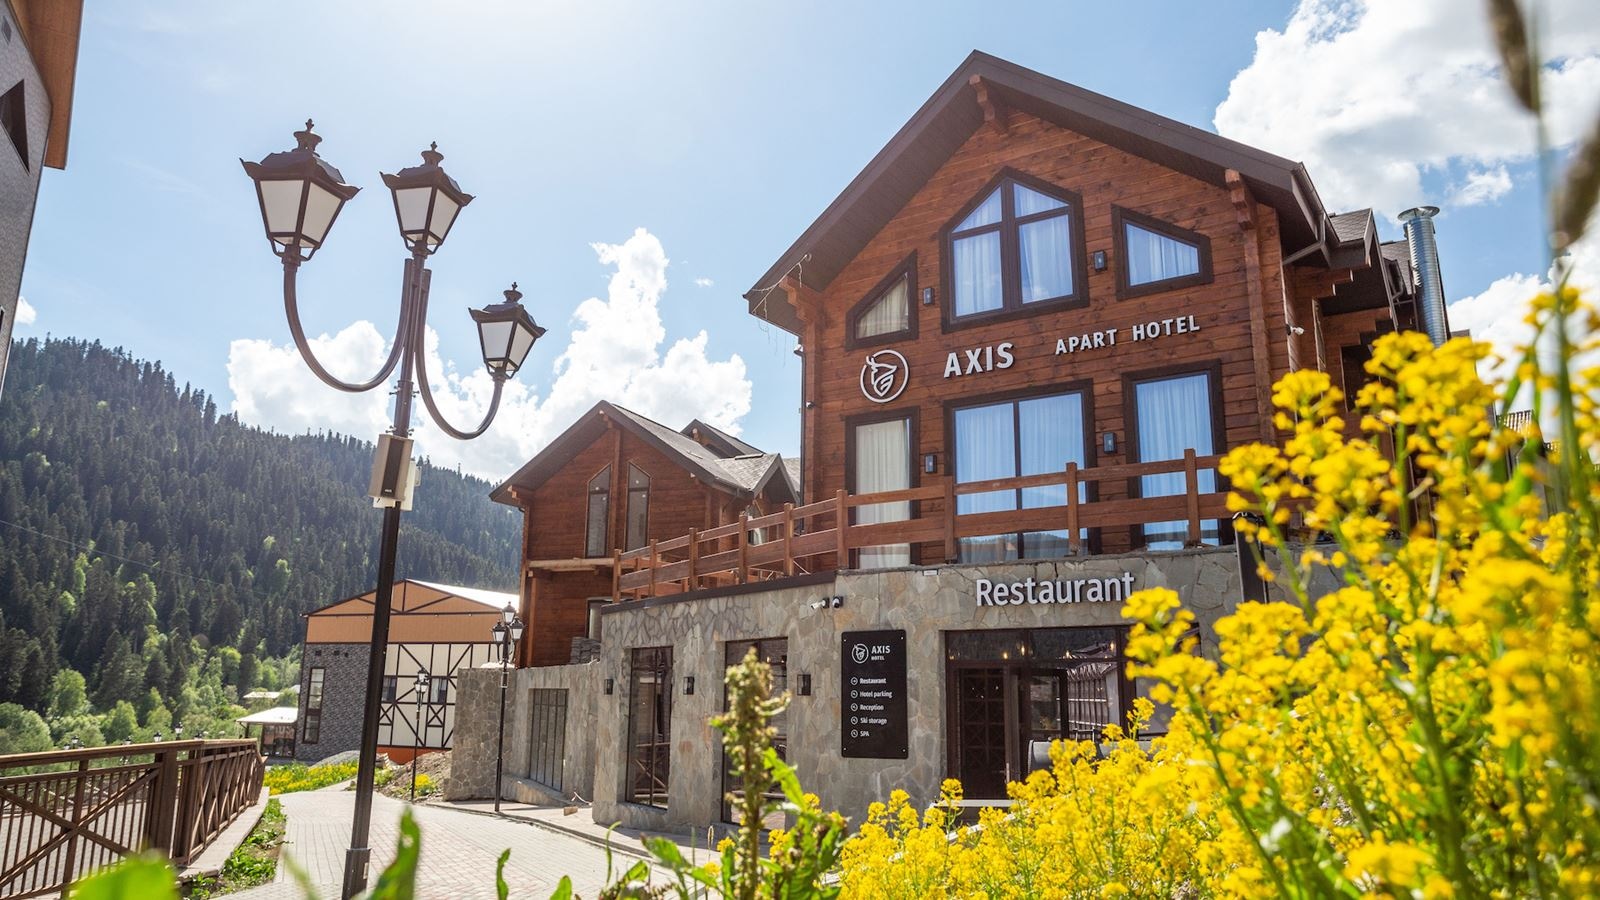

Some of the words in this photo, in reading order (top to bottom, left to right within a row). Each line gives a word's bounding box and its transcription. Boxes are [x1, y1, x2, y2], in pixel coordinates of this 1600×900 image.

[1055, 328, 1118, 355] APART
[1132, 315, 1200, 342] HOTEL
[943, 342, 1015, 378] AXIS
[976, 571, 1135, 607] Restaurant
[871, 645, 890, 654] AXIS
[874, 690, 892, 698] parking
